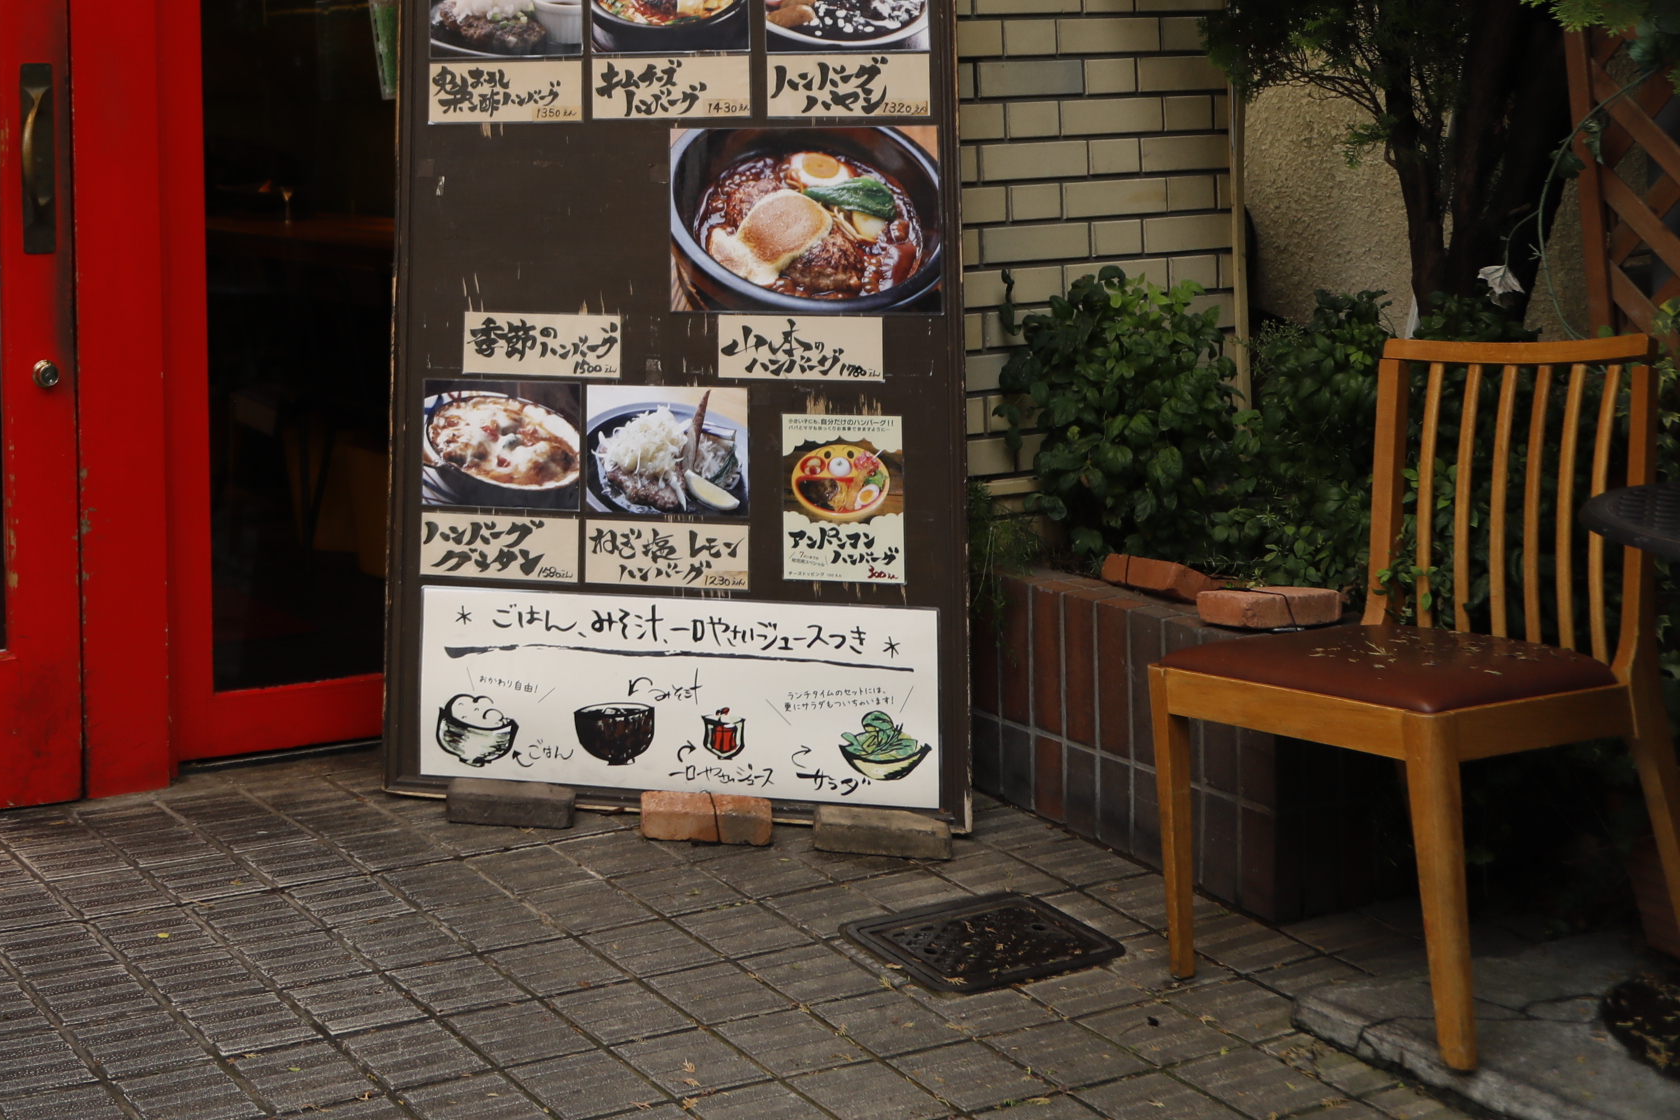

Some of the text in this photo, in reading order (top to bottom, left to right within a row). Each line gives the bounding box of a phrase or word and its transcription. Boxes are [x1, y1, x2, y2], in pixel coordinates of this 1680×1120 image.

[770, 56, 889, 99] ハンバーグ
[623, 81, 708, 117] ハンバーグ
[801, 84, 888, 115] ハヤシ
[720, 318, 825, 357] 山本の
[744, 347, 845, 377] ハンバーグ
[423, 519, 546, 549] ハンバーグ
[788, 527, 876, 550] アンパンマン
[830, 546, 900, 566] ハンバーグ
[619, 560, 713, 585] ハンバーグ
[528, 738, 574, 761] ごはん
